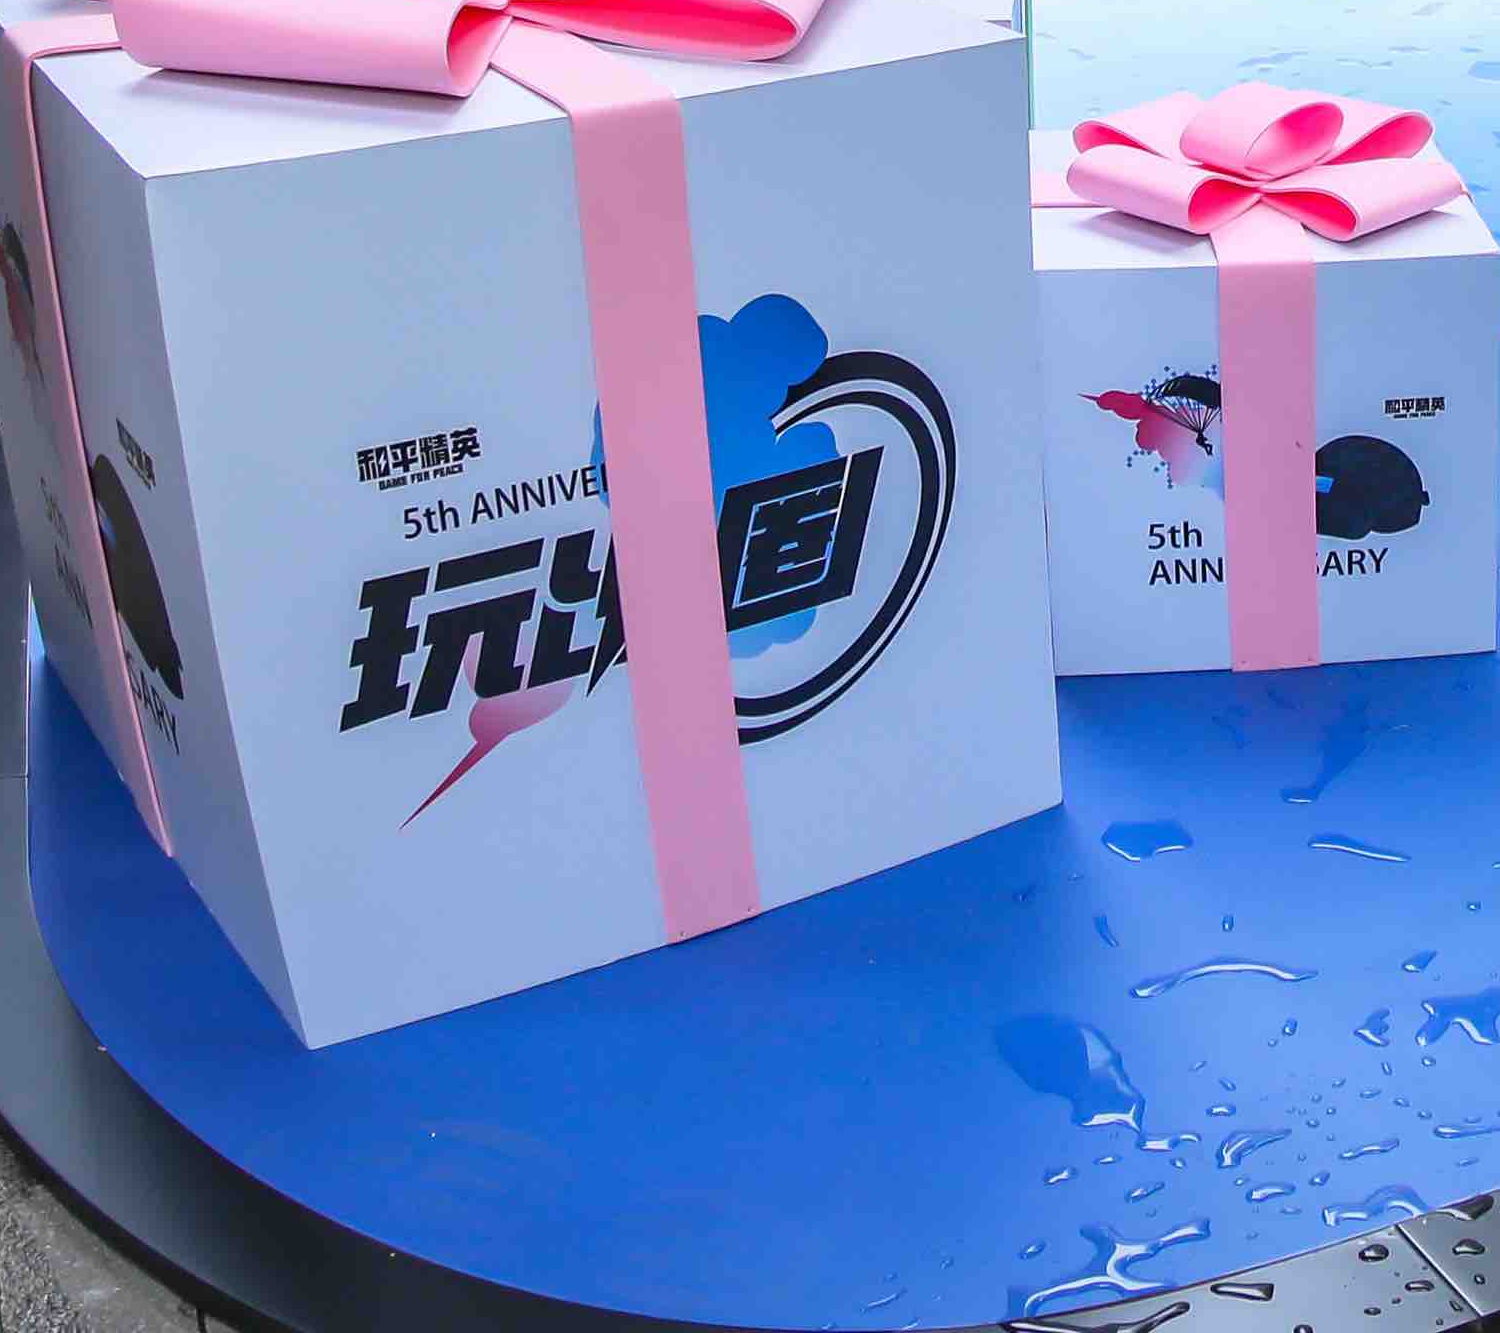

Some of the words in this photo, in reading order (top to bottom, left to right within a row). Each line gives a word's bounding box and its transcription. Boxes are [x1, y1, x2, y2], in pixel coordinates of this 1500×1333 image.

[356, 426, 481, 483] 和平精英
[403, 498, 461, 540] 5th
[1147, 520, 1203, 551] 5th
